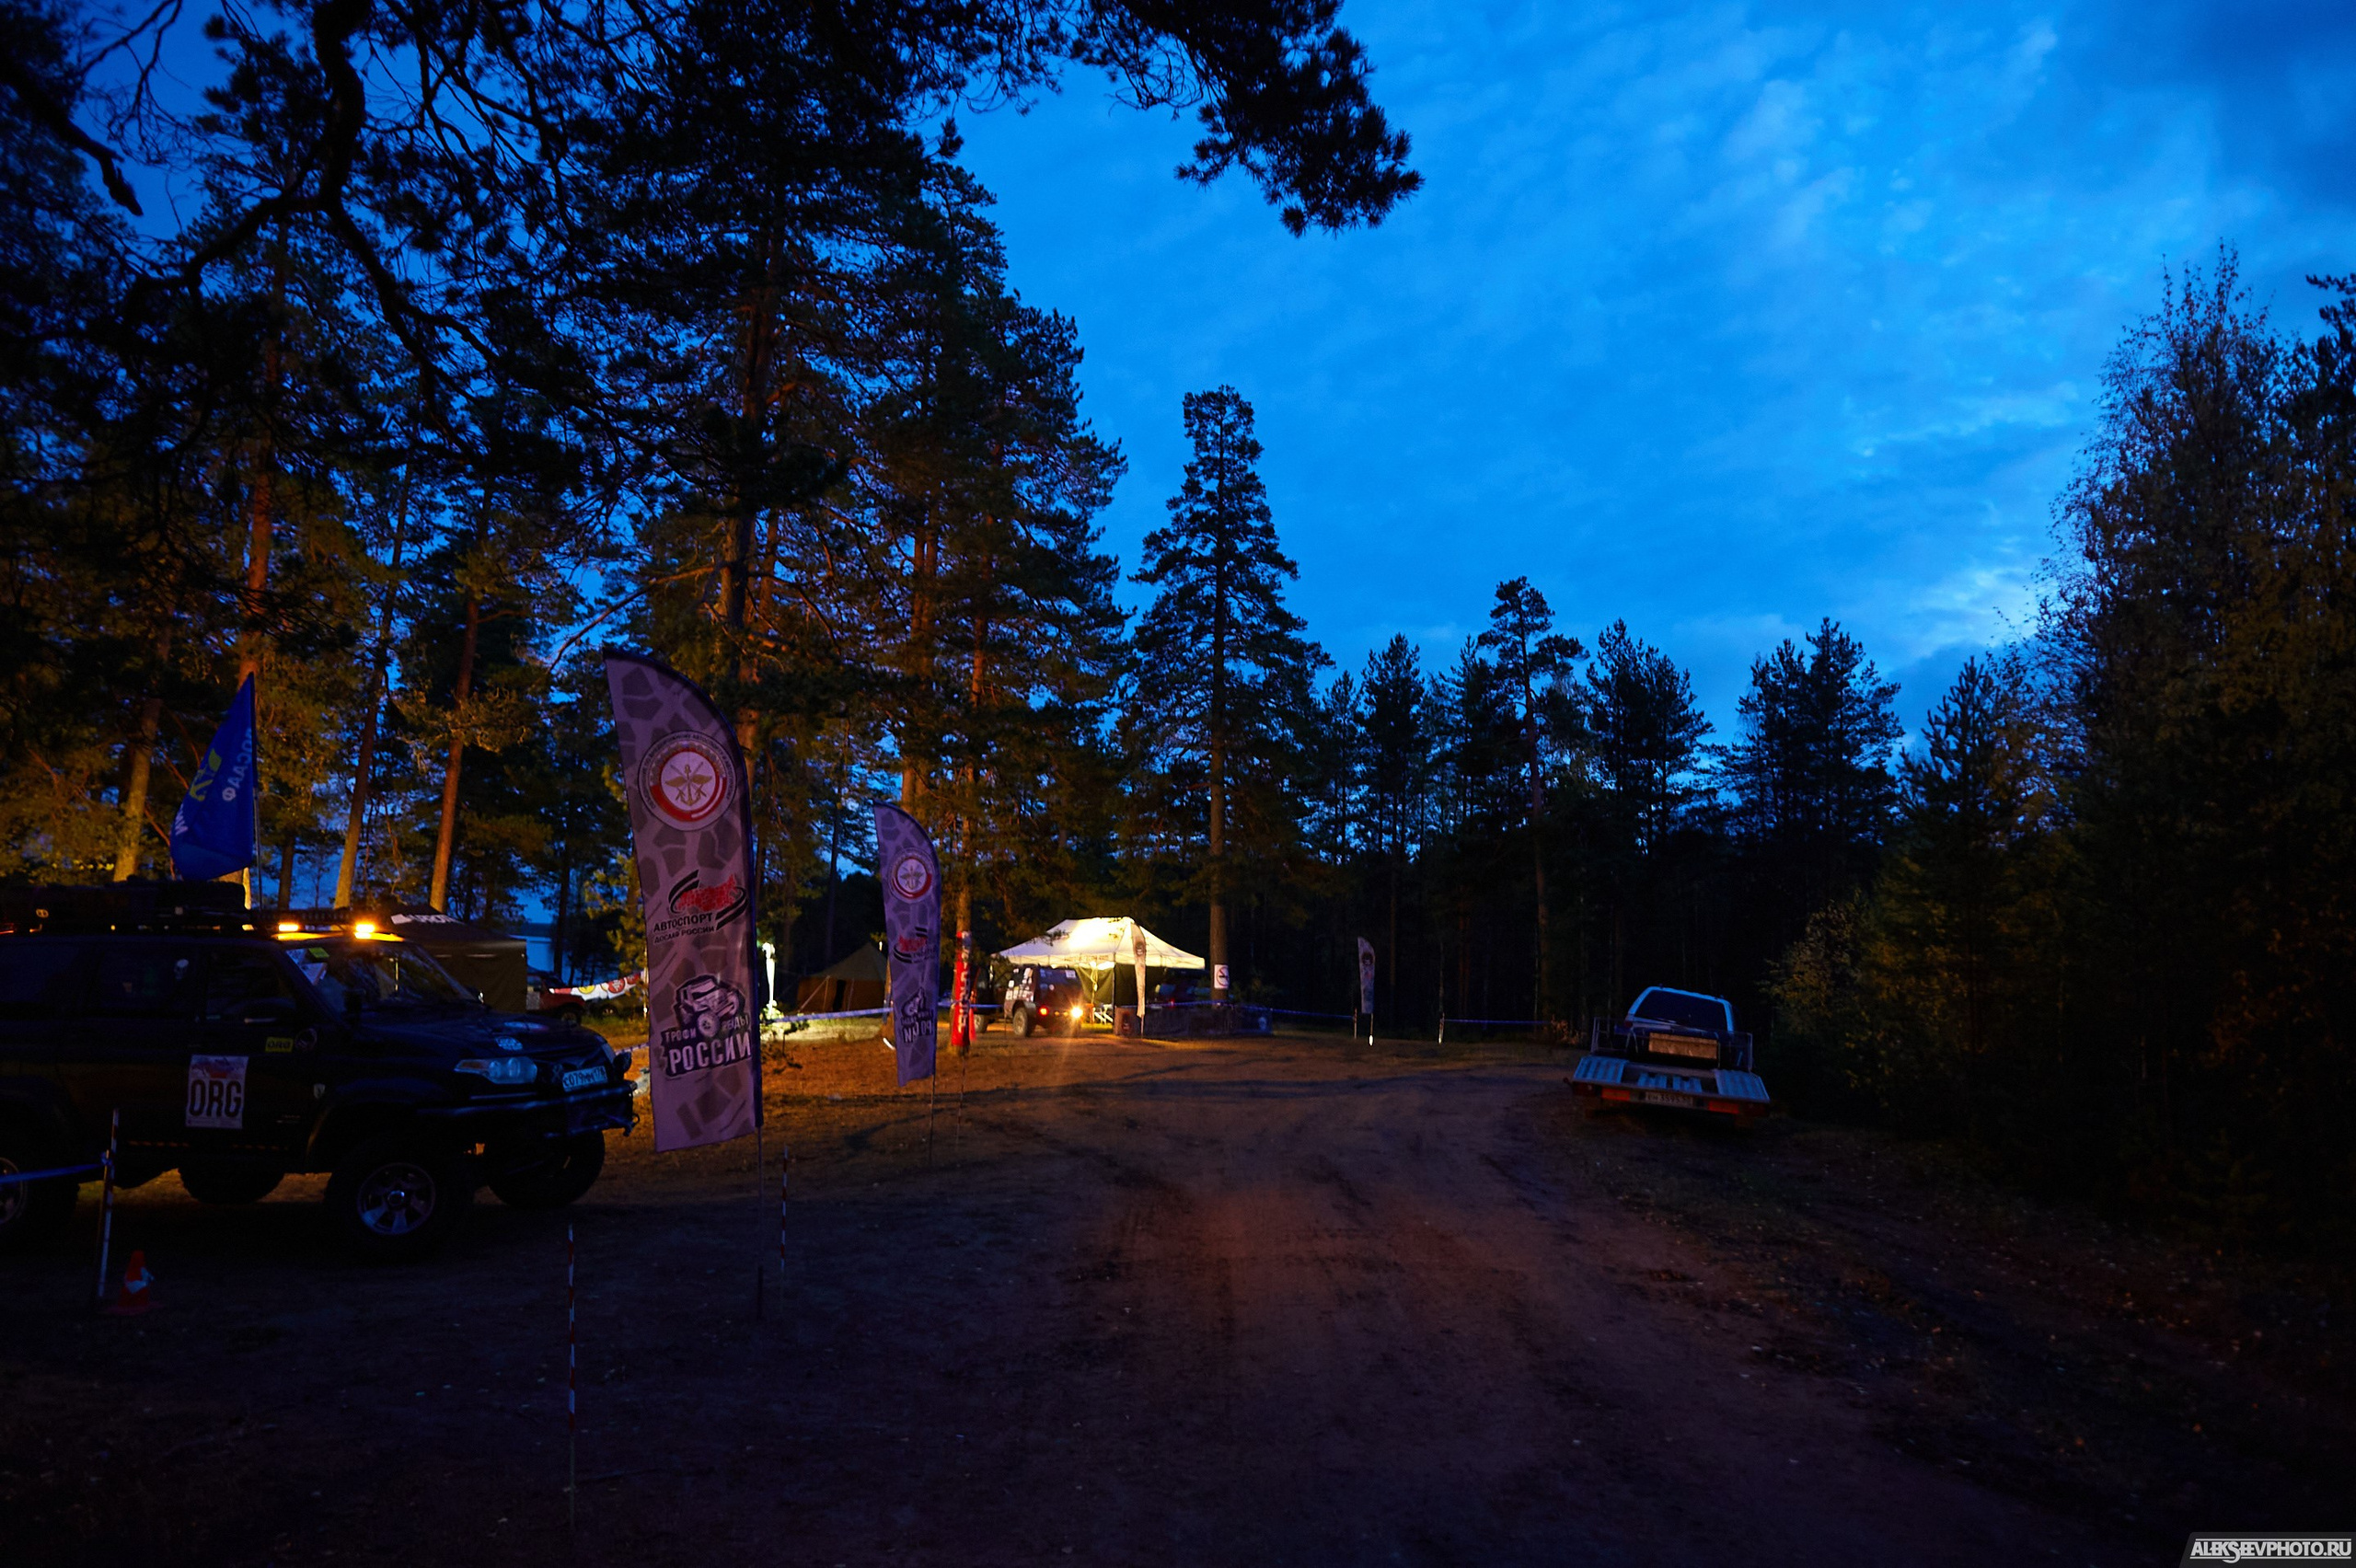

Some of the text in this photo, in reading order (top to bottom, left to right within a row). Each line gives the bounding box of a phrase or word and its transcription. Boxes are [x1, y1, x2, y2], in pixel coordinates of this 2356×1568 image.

[653, 912, 713, 933] АВТОСПОРТ
[681, 926, 715, 937] РОССИИ
[664, 1027, 697, 1043] ТРОФИ
[668, 1031, 752, 1075] РОССИИ
[189, 1078, 242, 1118] ORG
